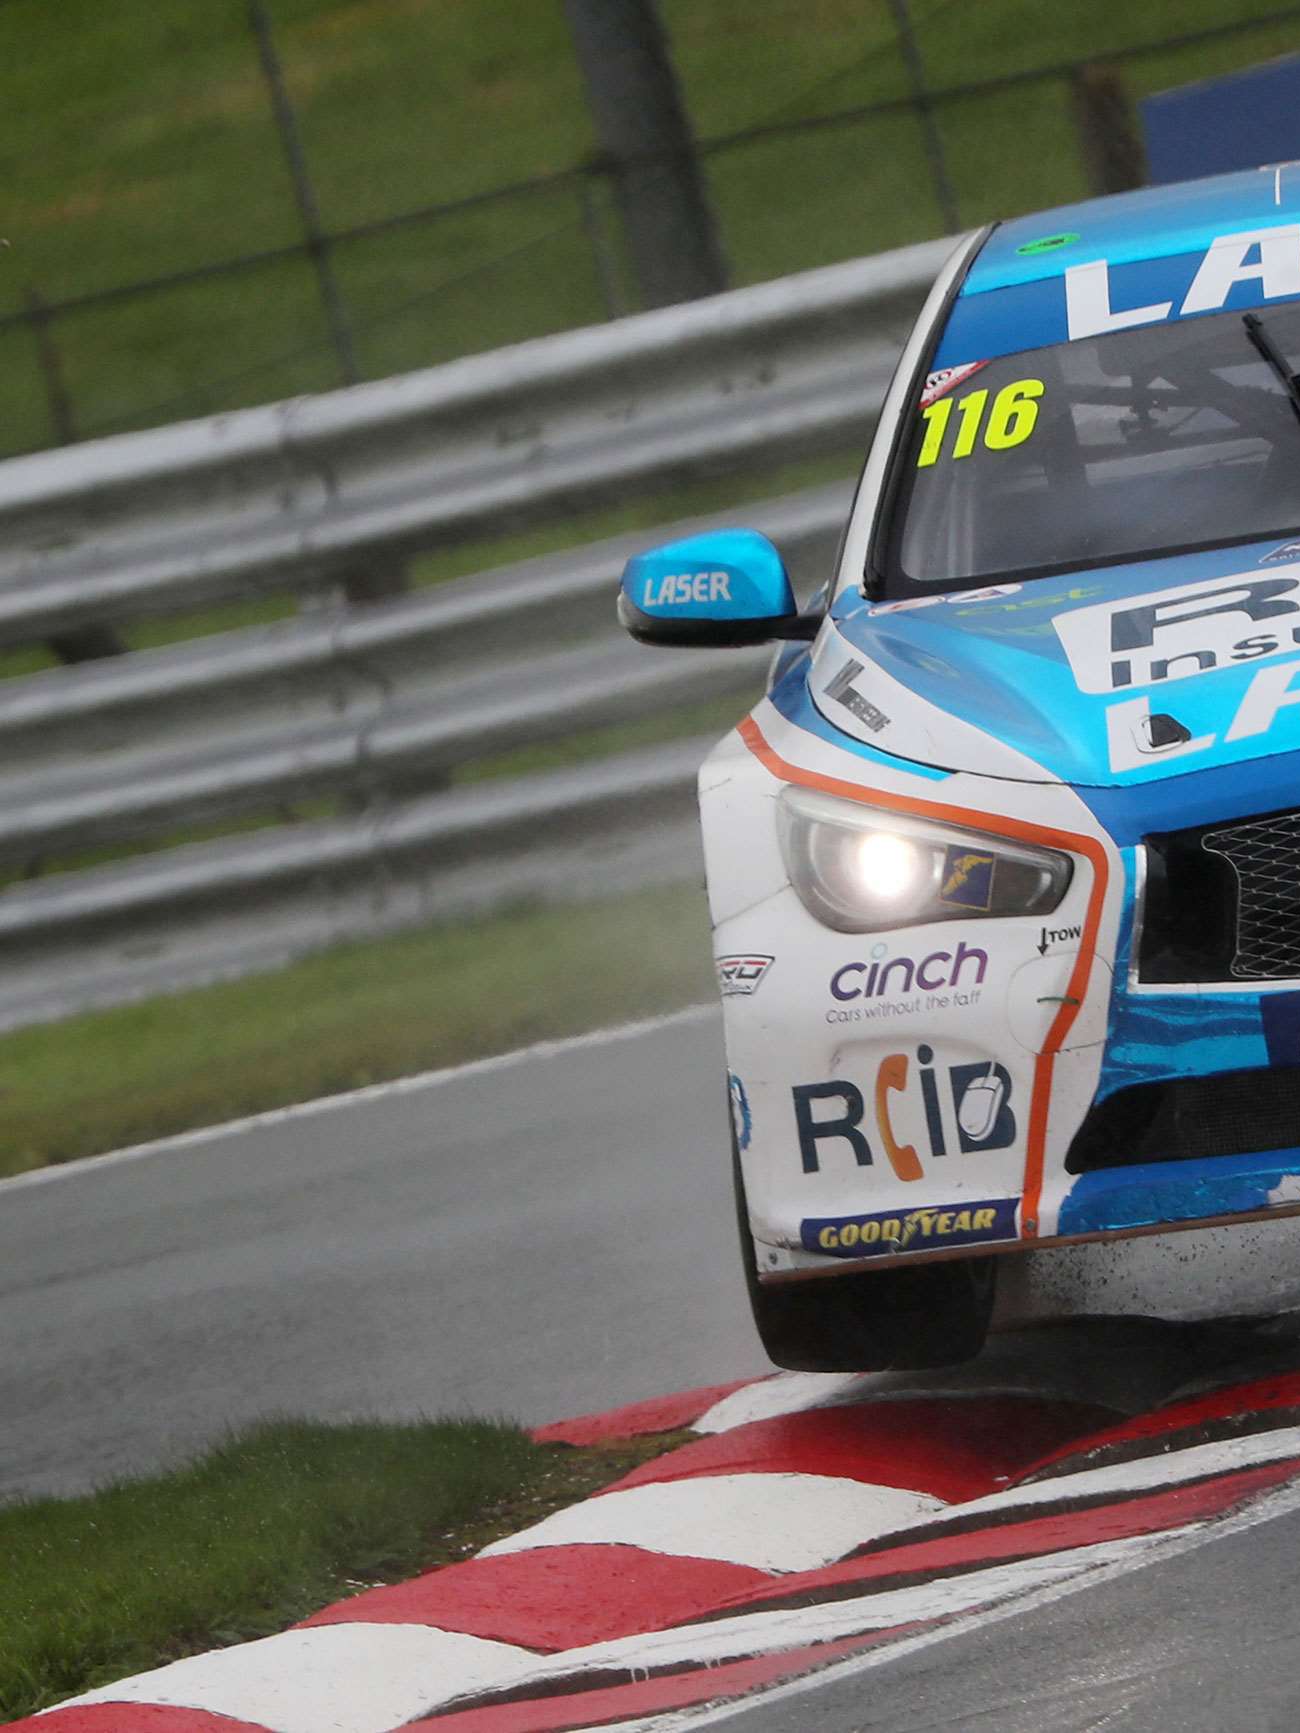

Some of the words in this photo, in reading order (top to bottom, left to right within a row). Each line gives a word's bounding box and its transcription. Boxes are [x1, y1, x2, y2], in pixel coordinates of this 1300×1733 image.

[917, 378, 1045, 468] 116
[643, 571, 732, 608] LASER
[1048, 925, 1081, 943] TOW
[829, 941, 989, 1002] cinch
[825, 1007, 862, 1024] Cars
[864, 1000, 922, 1019] without
[926, 993, 950, 1010] the
